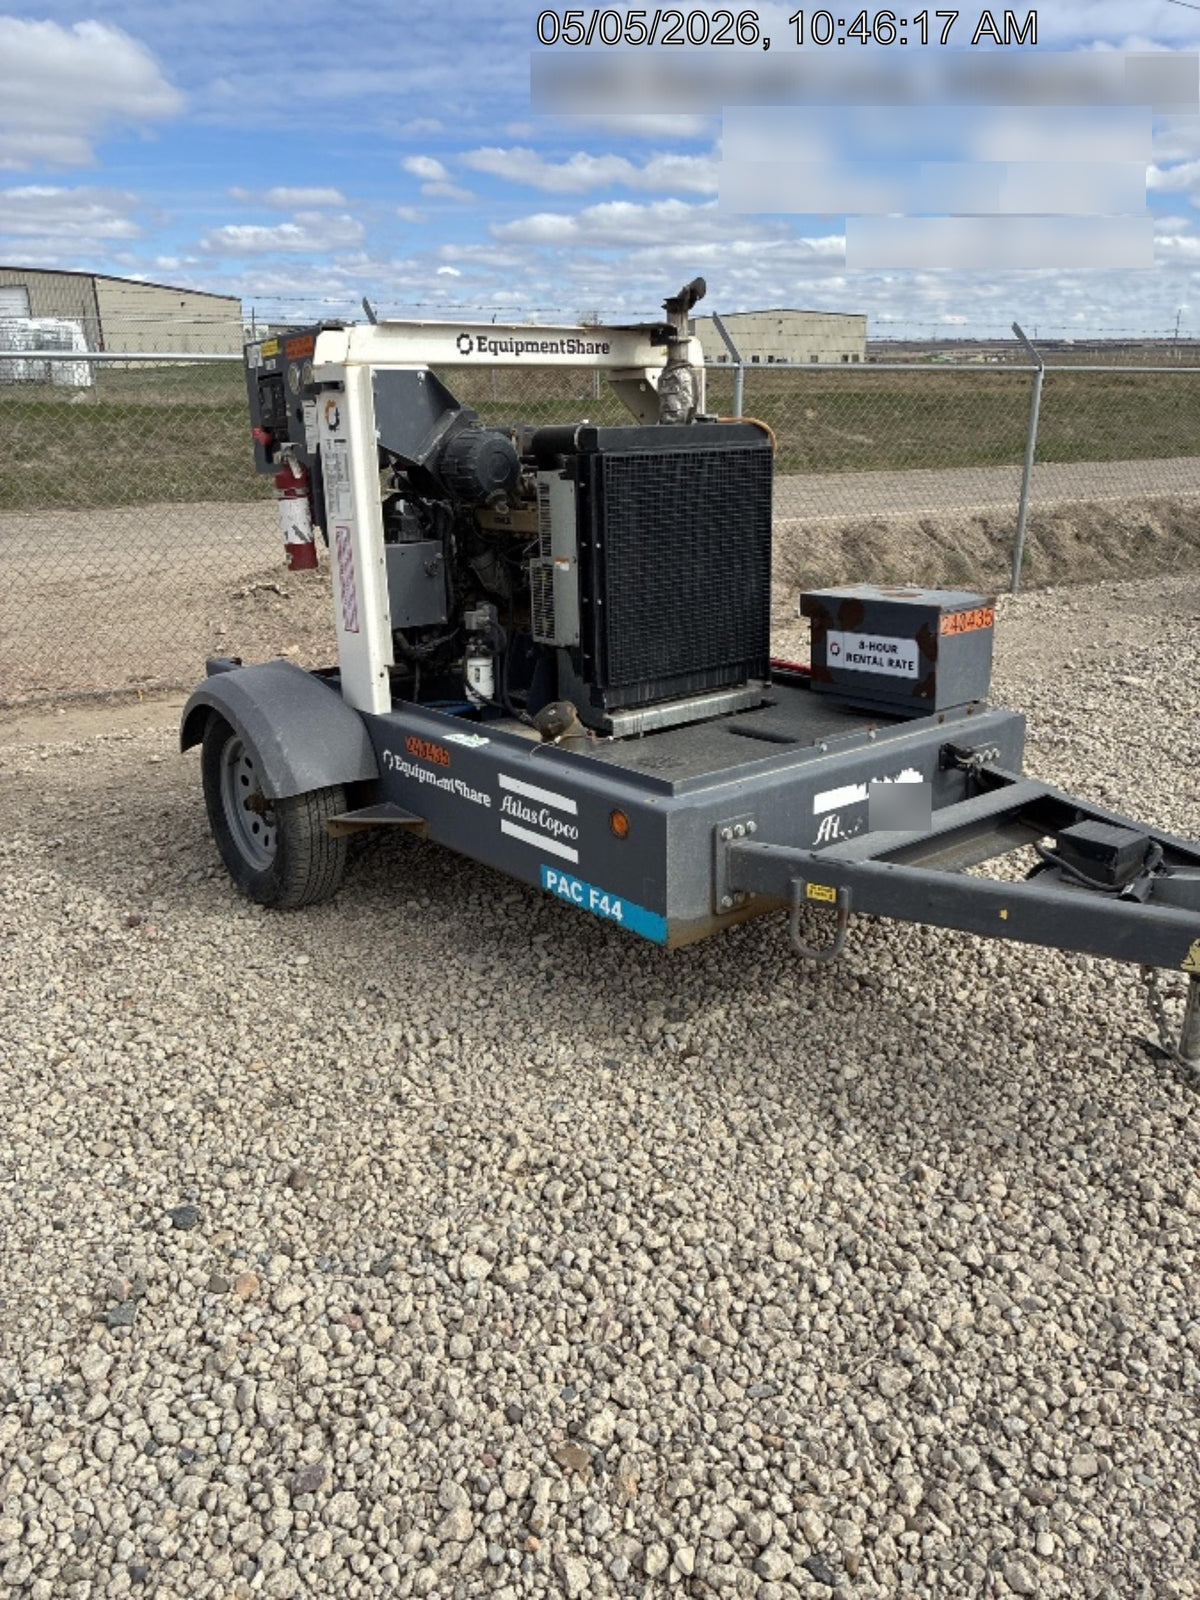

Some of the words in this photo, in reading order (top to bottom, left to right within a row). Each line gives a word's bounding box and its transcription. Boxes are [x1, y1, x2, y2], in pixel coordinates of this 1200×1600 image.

[476, 336, 611, 357] EquipmentShare
[858, 640, 899, 655] 8-HOUR
[845, 653, 885, 667] RENTAL
[887, 658, 915, 671] RATE
[500, 794, 539, 824] Atlas
[538, 808, 579, 840] Copco
[546, 870, 584, 903] PAC
[589, 888, 624, 922] F44
